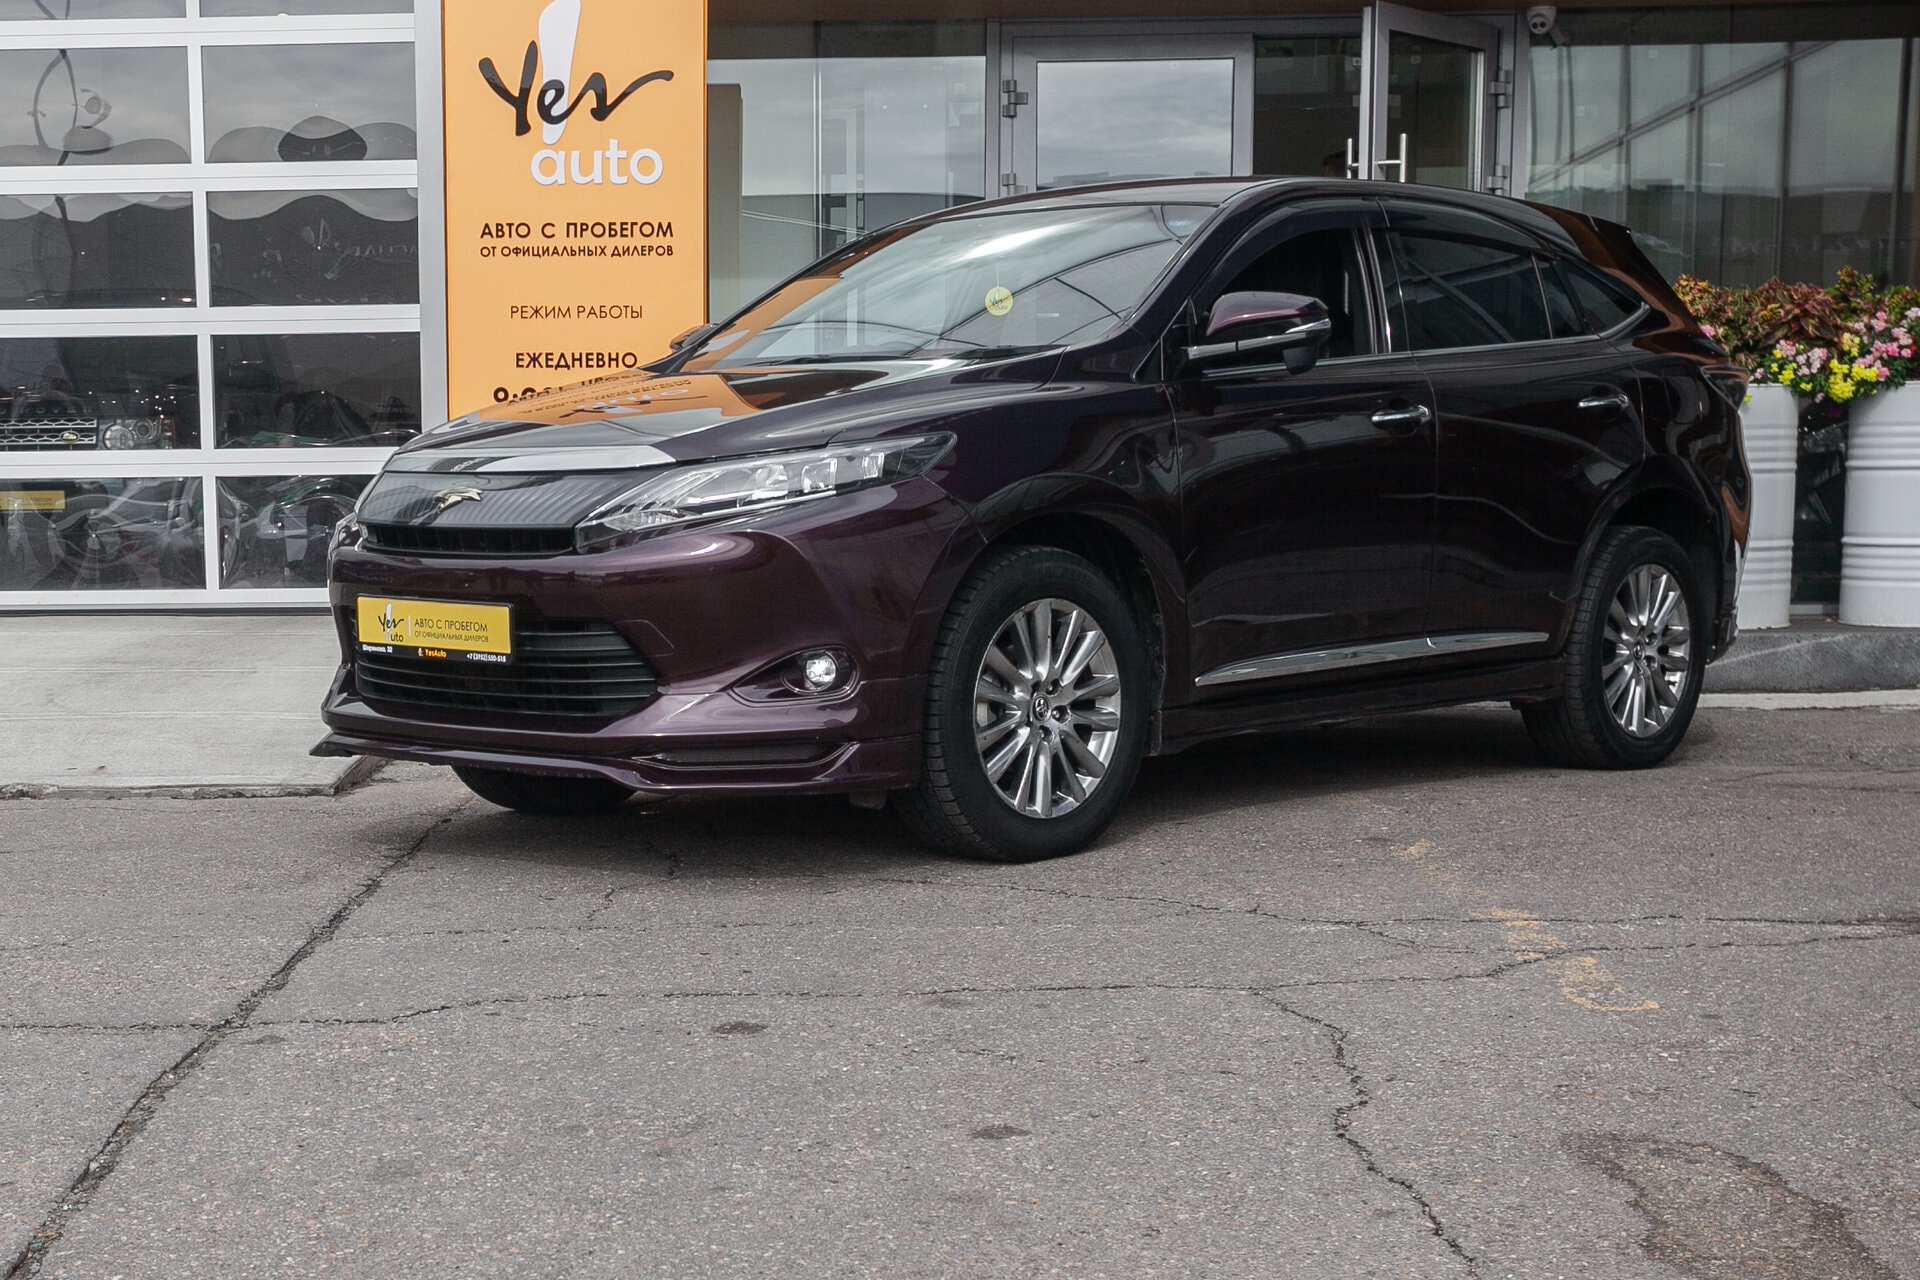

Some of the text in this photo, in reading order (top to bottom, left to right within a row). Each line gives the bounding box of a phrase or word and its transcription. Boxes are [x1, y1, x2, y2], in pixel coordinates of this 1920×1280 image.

[478, 40, 674, 136] Yes
[530, 139, 664, 185] auto
[480, 221, 674, 239] АВТО С ПРОБЕГОМ
[480, 245, 674, 258] ОТ ОФИЦИАЛЬНЫХ ДИЛЕРОВ
[510, 305, 643, 319] РЕЖИМ РАБОТЫ
[515, 352, 638, 370] ЕЖЕДНЕВНО
[414, 618, 488, 632] АВТО С ПРОБЕГОМ
[425, 648, 447, 658] YesAuto
